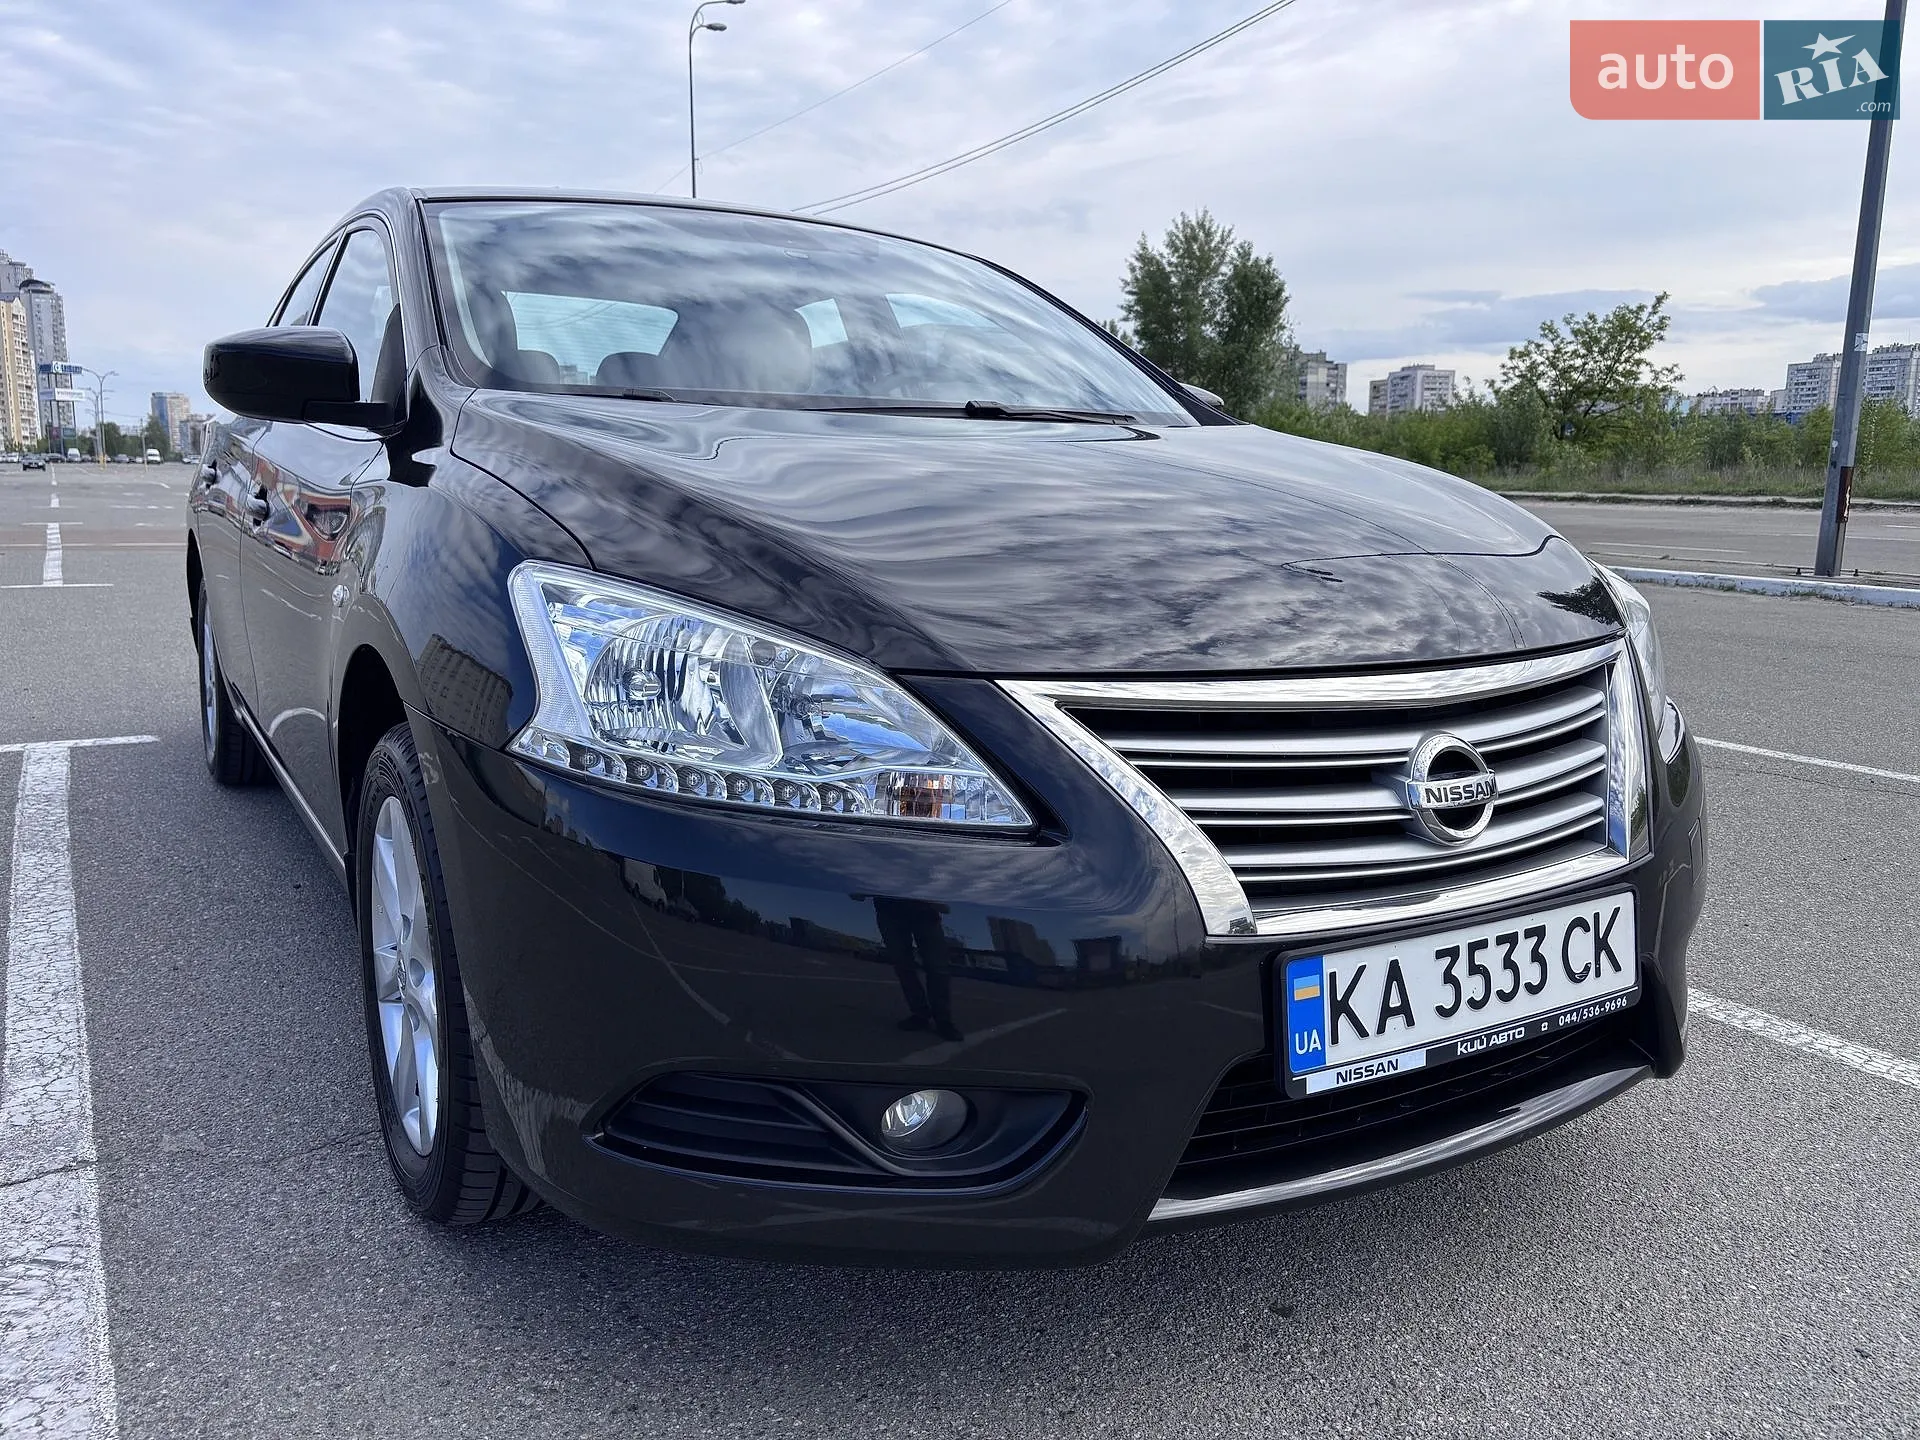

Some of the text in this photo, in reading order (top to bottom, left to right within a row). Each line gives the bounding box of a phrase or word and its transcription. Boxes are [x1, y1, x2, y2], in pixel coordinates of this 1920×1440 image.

[1424, 776, 1497, 804] NISSAN
[1328, 906, 1622, 1046] KA 3533 CK
[1558, 996, 1628, 1027] 044/536-9696
[1295, 1029, 1322, 1055] UA
[1336, 1058, 1399, 1085] NISSAN
